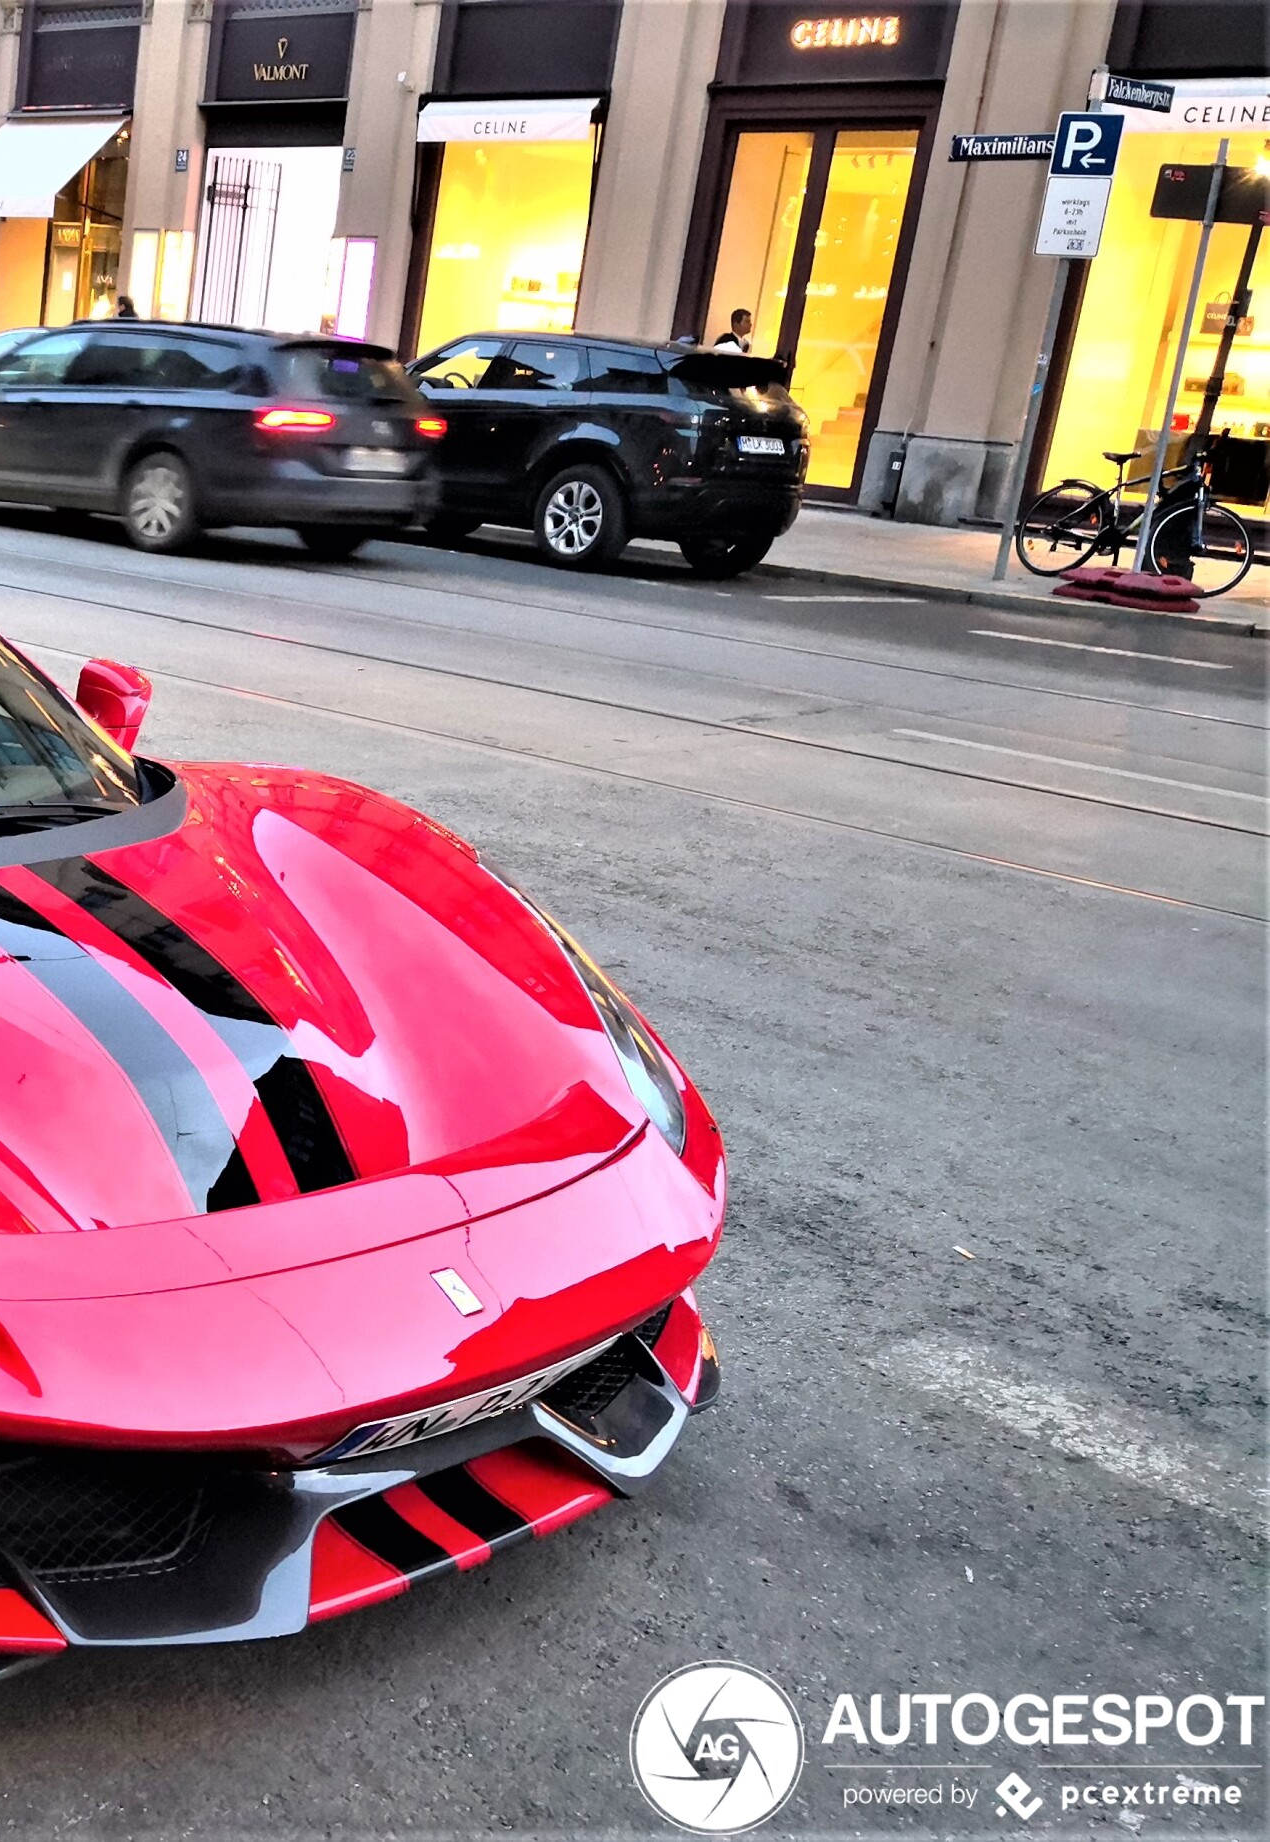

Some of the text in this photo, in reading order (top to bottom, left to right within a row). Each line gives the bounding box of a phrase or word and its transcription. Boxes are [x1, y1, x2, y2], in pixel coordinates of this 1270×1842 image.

[791, 17, 900, 49] CELINE
[253, 64, 309, 80] VALMONT
[1184, 106, 1270, 123] CELINE
[473, 121, 527, 134] CELINE
[1062, 121, 1103, 168] P
